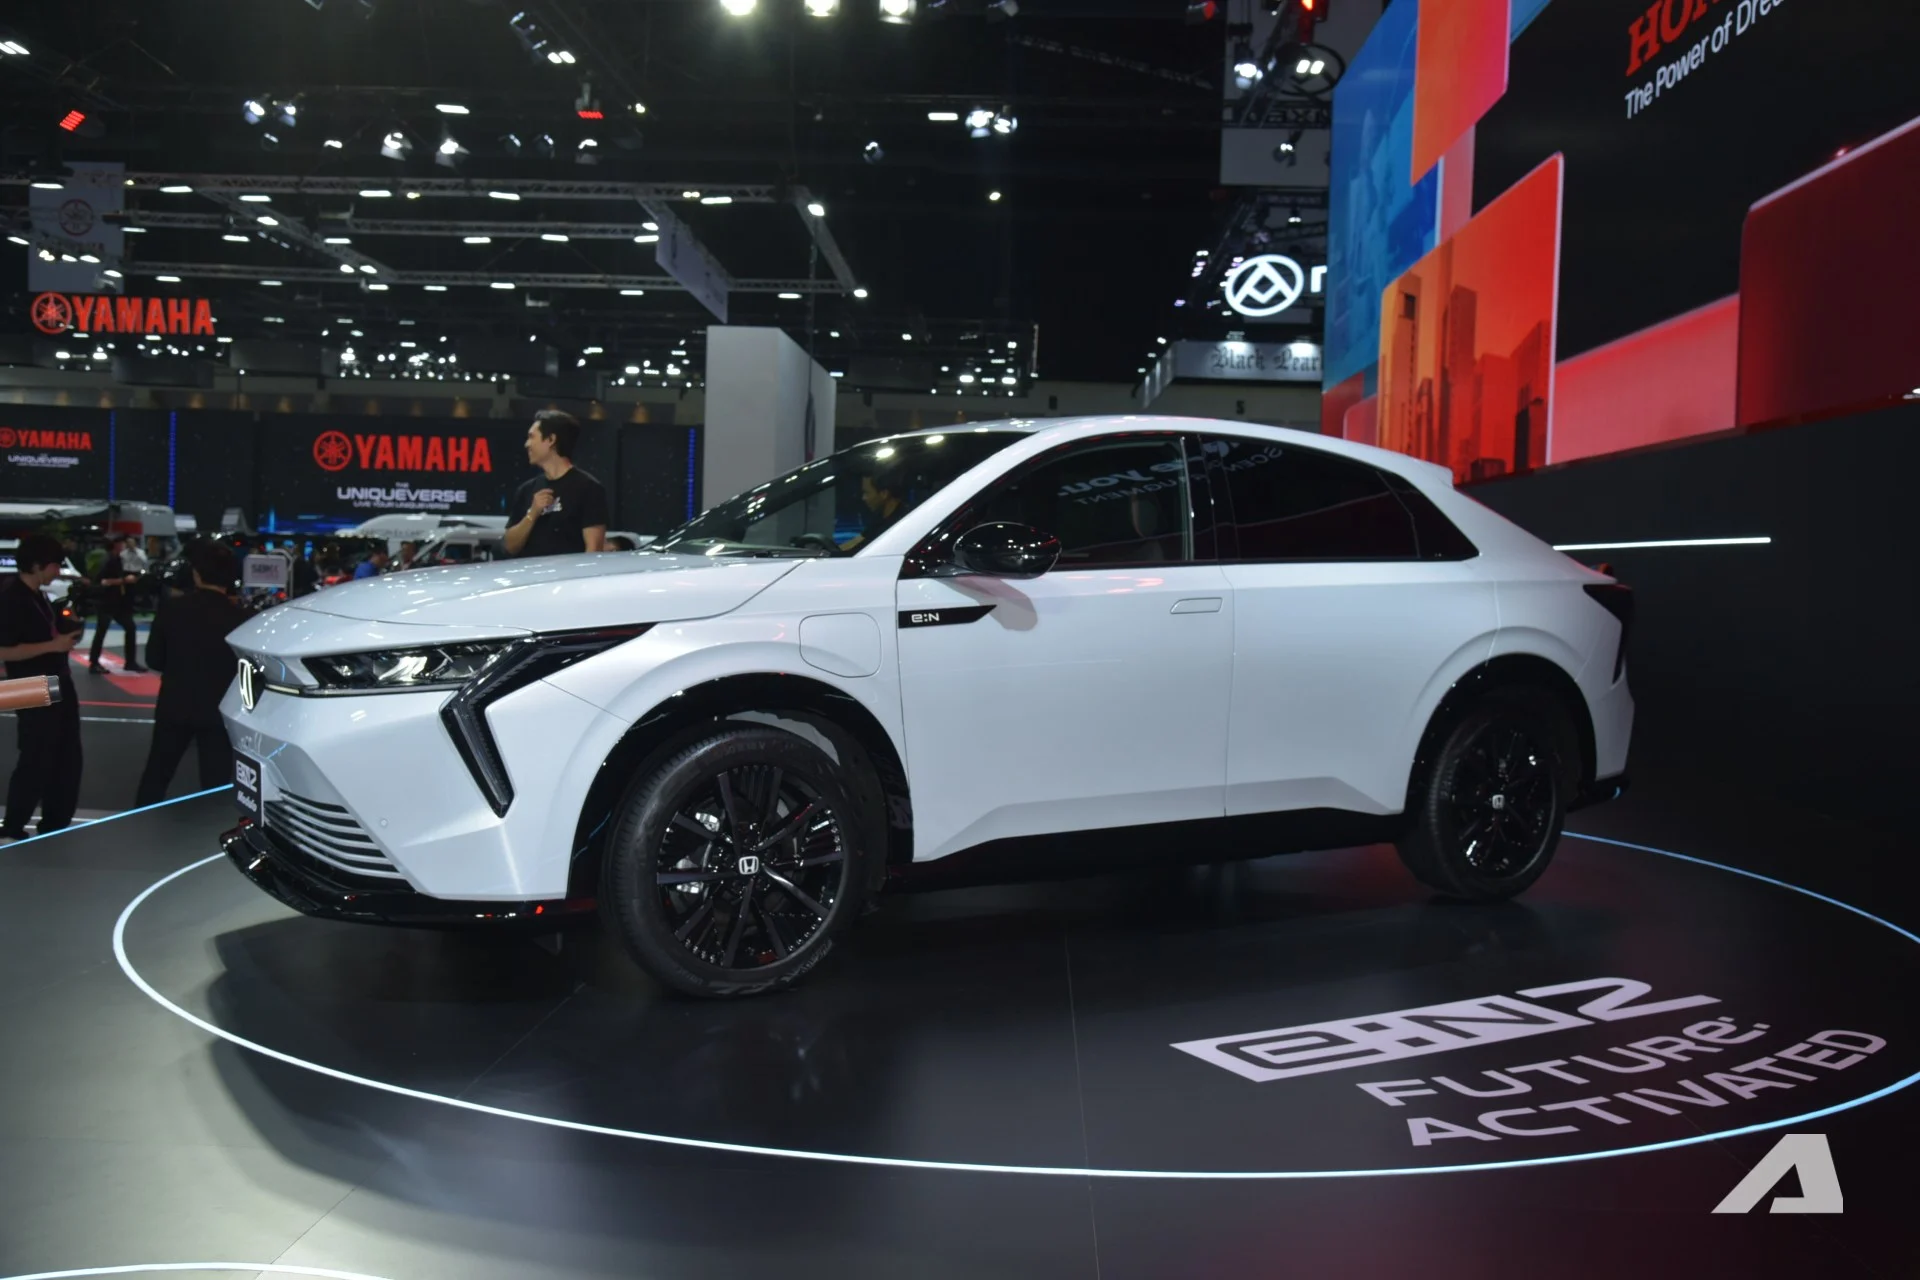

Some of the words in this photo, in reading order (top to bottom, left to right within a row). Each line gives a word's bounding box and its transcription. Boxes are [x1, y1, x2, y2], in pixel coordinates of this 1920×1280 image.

[1624, 82, 1653, 119] The
[1655, 35, 1709, 98] Power
[1711, 11, 1733, 53] of
[1736, 0, 1784, 36] Dre
[71, 295, 215, 335] YAMAHA
[1210, 346, 1265, 371] Black
[17, 430, 92, 450] YAMAHA
[354, 434, 492, 473] YAMAHA
[337, 486, 467, 503] UNIQUEVERSE
[911, 612, 940, 623] e:N
[1407, 1029, 1887, 1146] ACTIVATED
